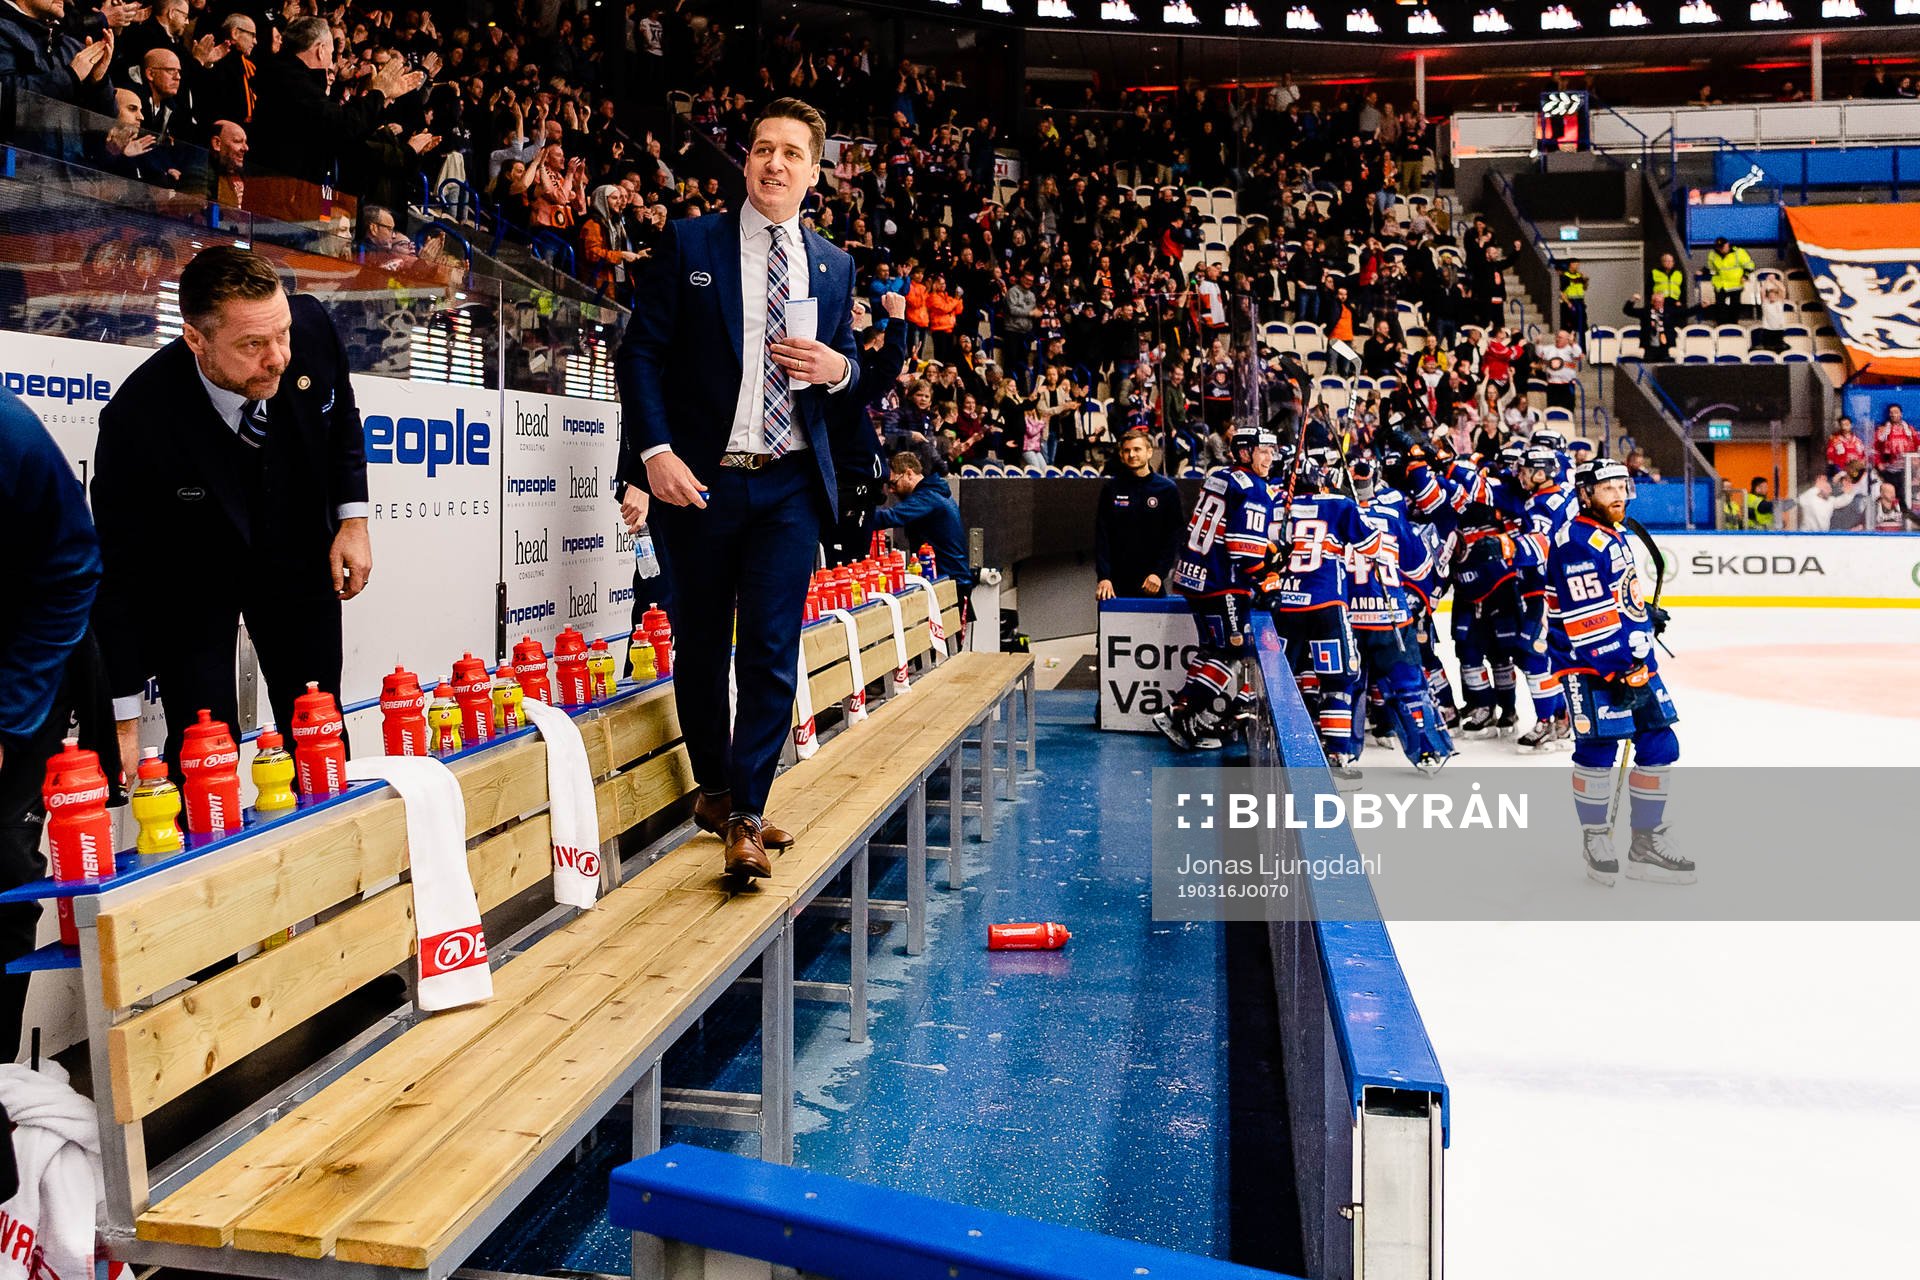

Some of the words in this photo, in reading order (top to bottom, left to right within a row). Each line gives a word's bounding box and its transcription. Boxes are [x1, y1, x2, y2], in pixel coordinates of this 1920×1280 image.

[0, 372, 111, 405] people
[515, 400, 549, 437] head
[562, 415, 605, 436] inpeople
[507, 475, 556, 496] inpeople
[568, 466, 598, 499] head
[375, 500, 489, 519] RESOURCES
[1246, 509, 1266, 533] 10
[514, 528, 549, 565] head
[562, 533, 604, 554] inpeople
[1692, 550, 1824, 575] ŠKODA
[568, 581, 597, 618] head
[1567, 572, 1604, 602] 85
[506, 600, 555, 625] inpeople
